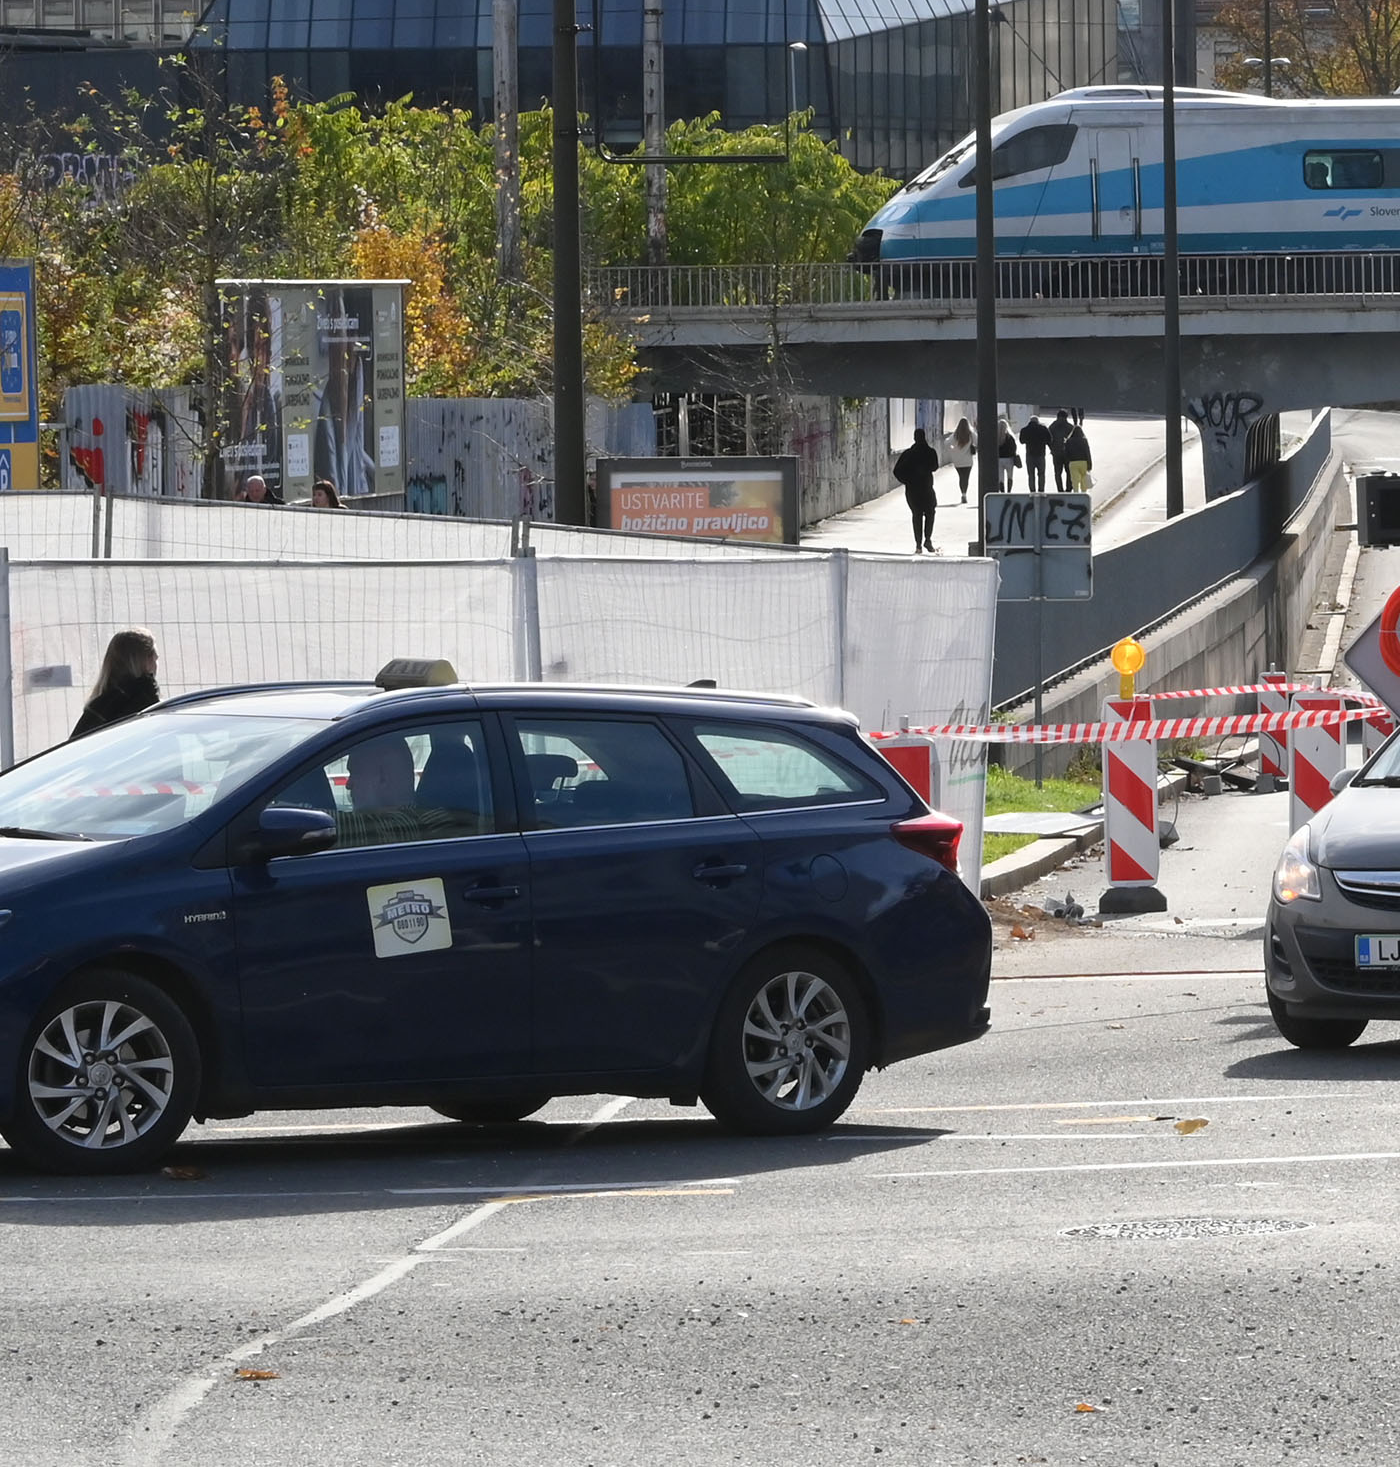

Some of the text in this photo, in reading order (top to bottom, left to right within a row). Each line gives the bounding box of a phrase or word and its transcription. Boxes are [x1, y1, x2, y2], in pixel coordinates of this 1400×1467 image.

[620, 492, 705, 510] USTVARITE
[620, 512, 770, 534] božično pravljico
[386, 903, 430, 920] METRO
[1378, 939, 1400, 962] LJ
